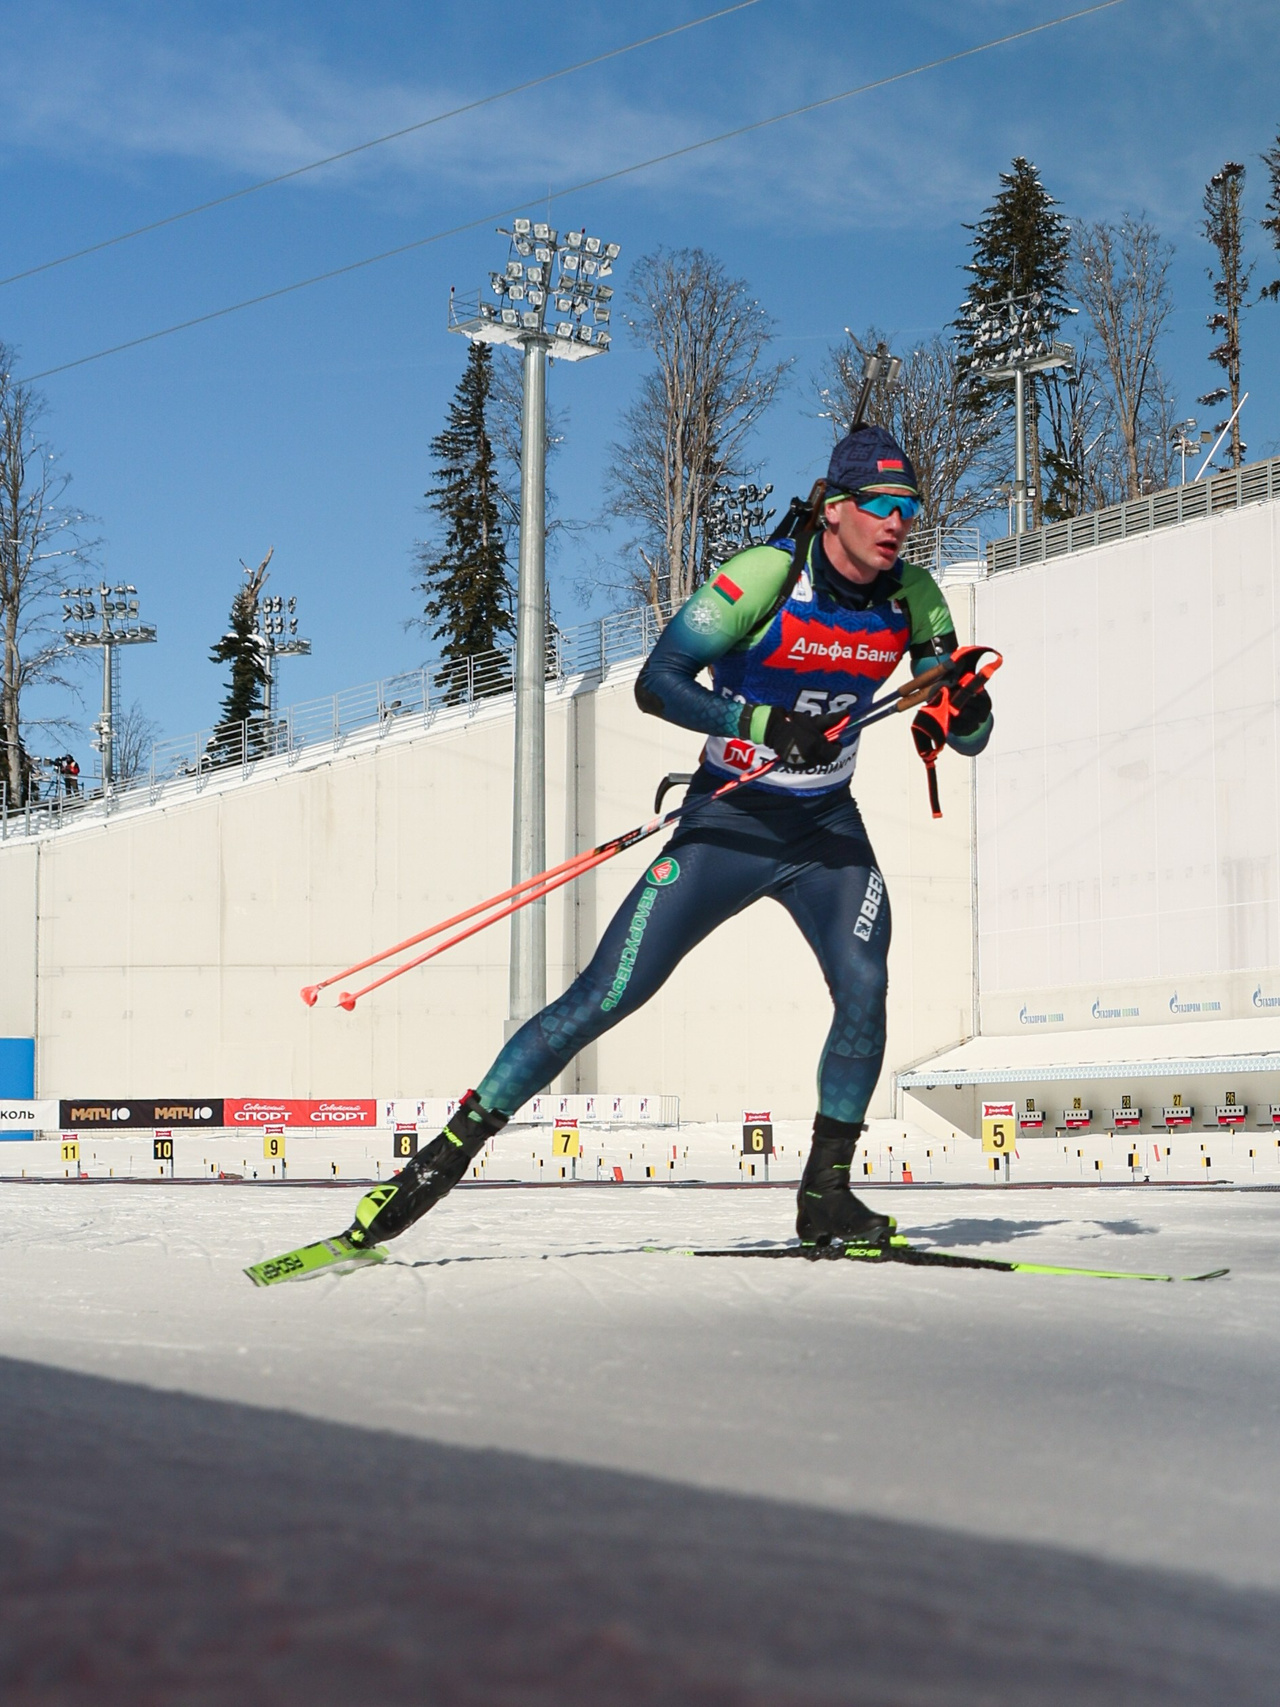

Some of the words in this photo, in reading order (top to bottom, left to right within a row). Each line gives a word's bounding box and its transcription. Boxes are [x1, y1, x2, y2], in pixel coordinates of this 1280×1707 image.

[788, 636, 853, 660] Альфа
[855, 643, 899, 664] Банк
[601, 887, 658, 1011] БЕЛОРУСНЕФТЬ
[0, 1110, 35, 1120] КОЛЬ
[233, 1111, 293, 1121] СПОРТ
[310, 1111, 368, 1122] СПОРТ
[561, 1134, 571, 1153] 7
[751, 1128, 764, 1151] 6
[992, 1124, 1005, 1148] 5
[63, 1145, 76, 1159] 11
[155, 1142, 171, 1158] 10
[270, 1139, 278, 1156] 9
[400, 1136, 411, 1155] 8
[845, 1248, 882, 1257] FISCHER
